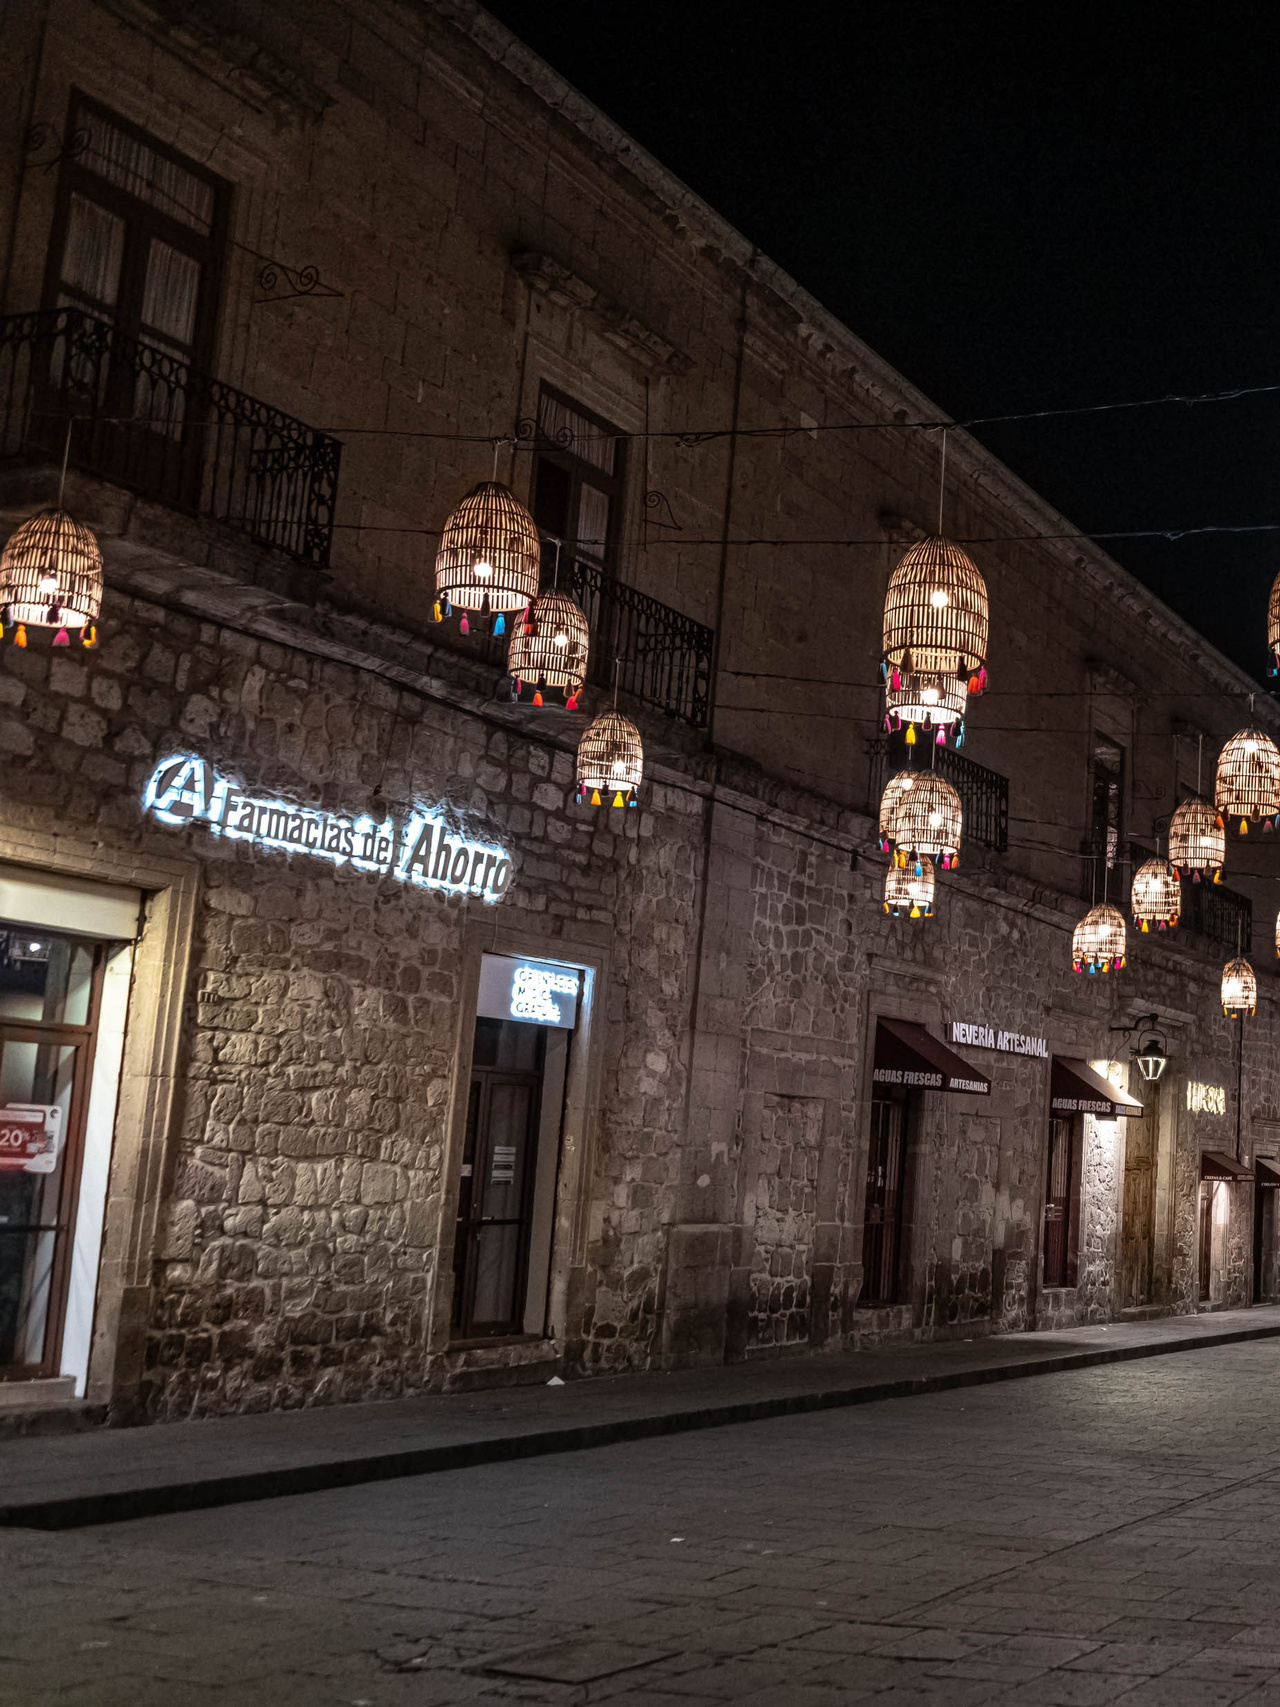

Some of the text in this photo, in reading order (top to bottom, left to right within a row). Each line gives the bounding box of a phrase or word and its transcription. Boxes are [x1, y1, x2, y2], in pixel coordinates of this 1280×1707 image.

[217, 786, 512, 895] Farmacias del Ahorro
[952, 1021, 1049, 1058] NEVERÍA ARTESANAL
[872, 1068, 903, 1084] AGUAS
[903, 1070, 943, 1087] FRESCAS
[1052, 1097, 1078, 1110] AGUAS
[1078, 1099, 1111, 1113] FRESCAS
